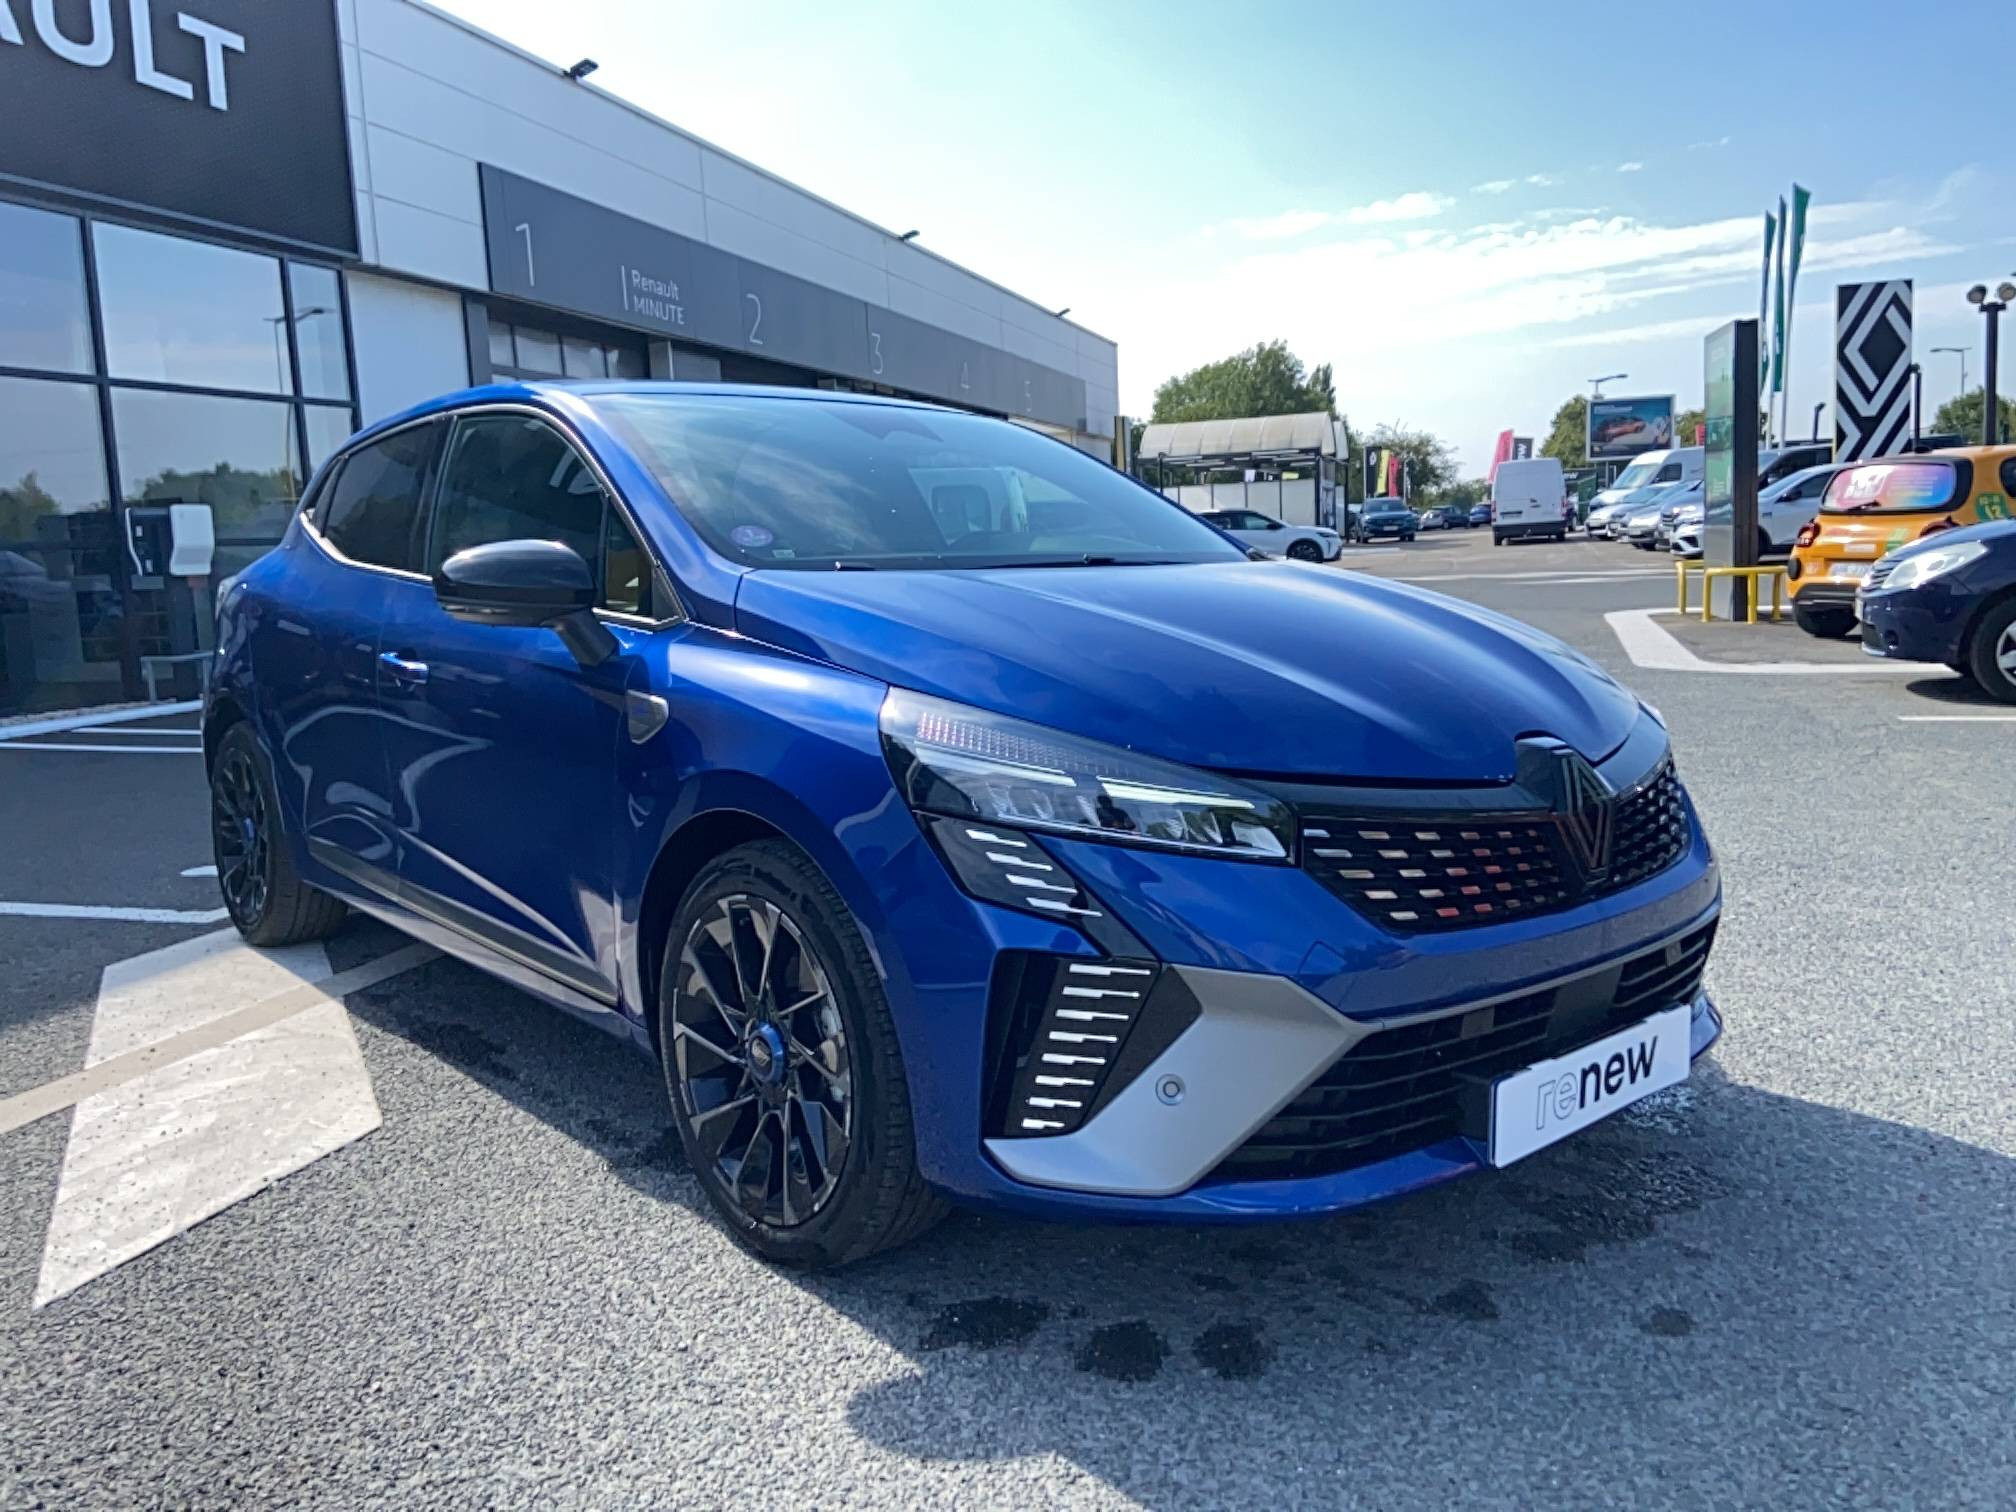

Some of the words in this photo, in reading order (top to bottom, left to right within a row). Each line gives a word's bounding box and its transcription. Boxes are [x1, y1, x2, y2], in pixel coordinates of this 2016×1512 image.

[0, 0, 246, 111] ULT
[515, 223, 535, 286] 1
[631, 269, 679, 301] Renault
[633, 295, 685, 325] MINUTE
[746, 293, 764, 345] 2
[872, 332, 883, 374] 3
[1536, 1035, 1658, 1130] renew
